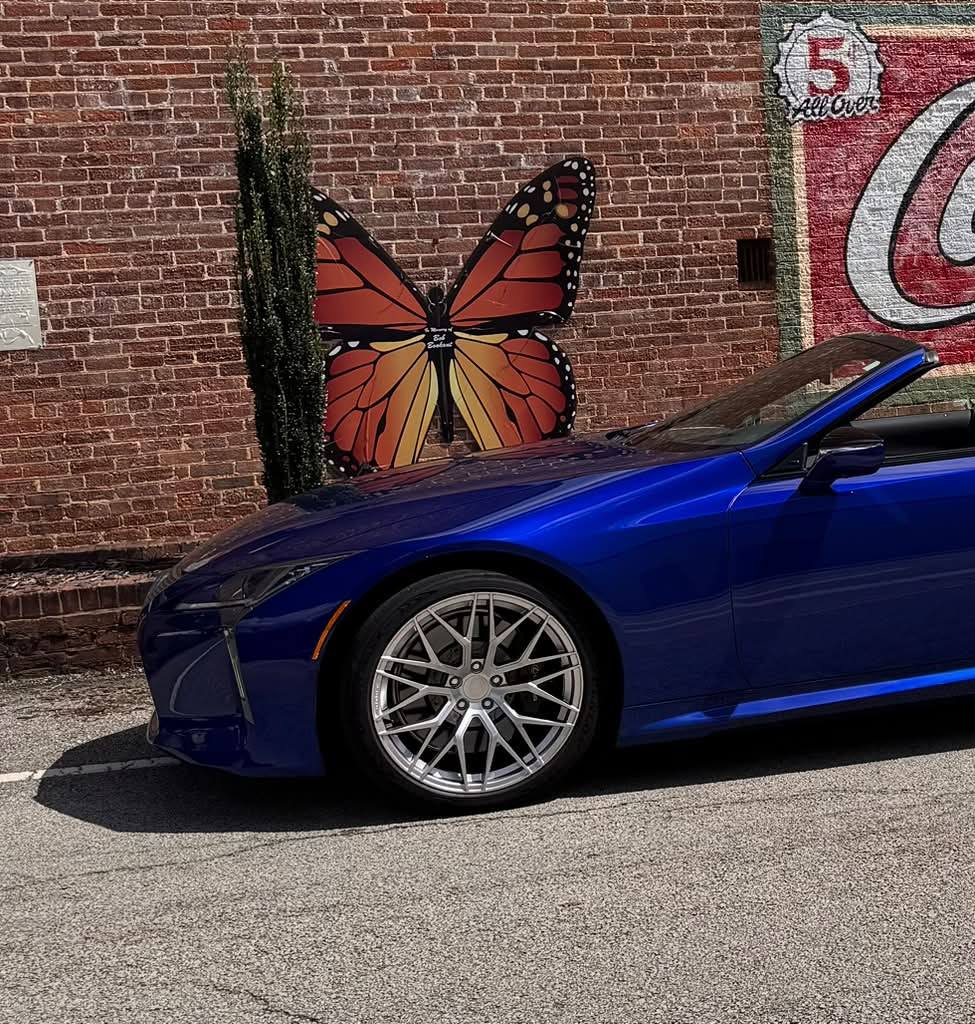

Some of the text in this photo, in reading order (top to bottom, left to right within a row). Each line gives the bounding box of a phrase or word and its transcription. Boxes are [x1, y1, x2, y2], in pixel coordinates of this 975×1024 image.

[807, 36, 849, 96] 5
[792, 94, 879, 119] All Over
